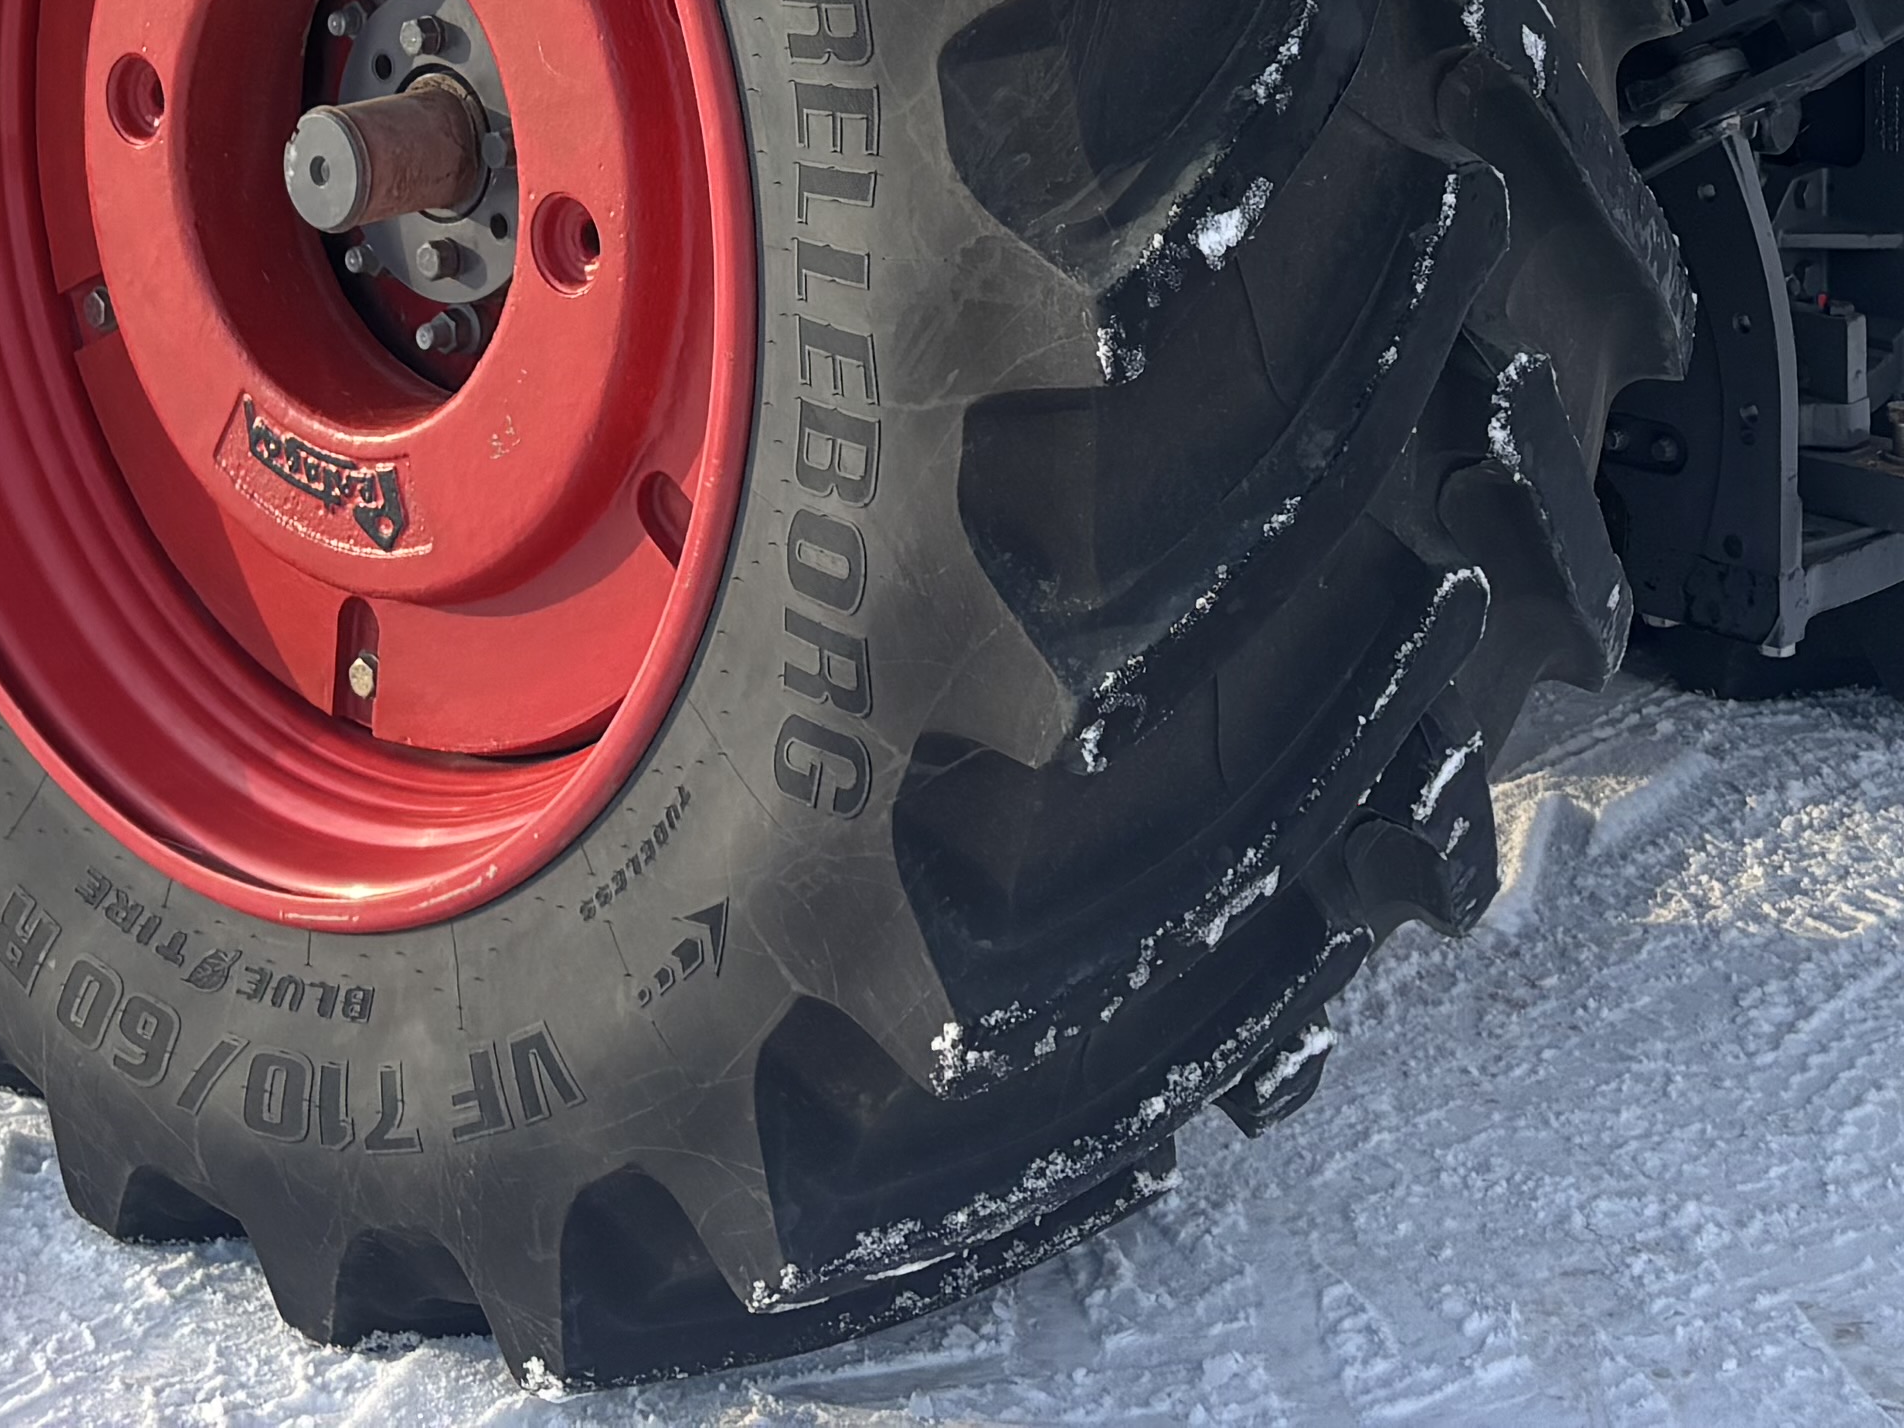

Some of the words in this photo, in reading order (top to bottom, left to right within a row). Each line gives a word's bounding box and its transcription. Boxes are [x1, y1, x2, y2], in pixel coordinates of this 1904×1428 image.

[74, 864, 189, 968] TIRE
[236, 964, 376, 1024] BLUE
[56, 952, 424, 1155] 710/60
[451, 1020, 587, 1143] VF
